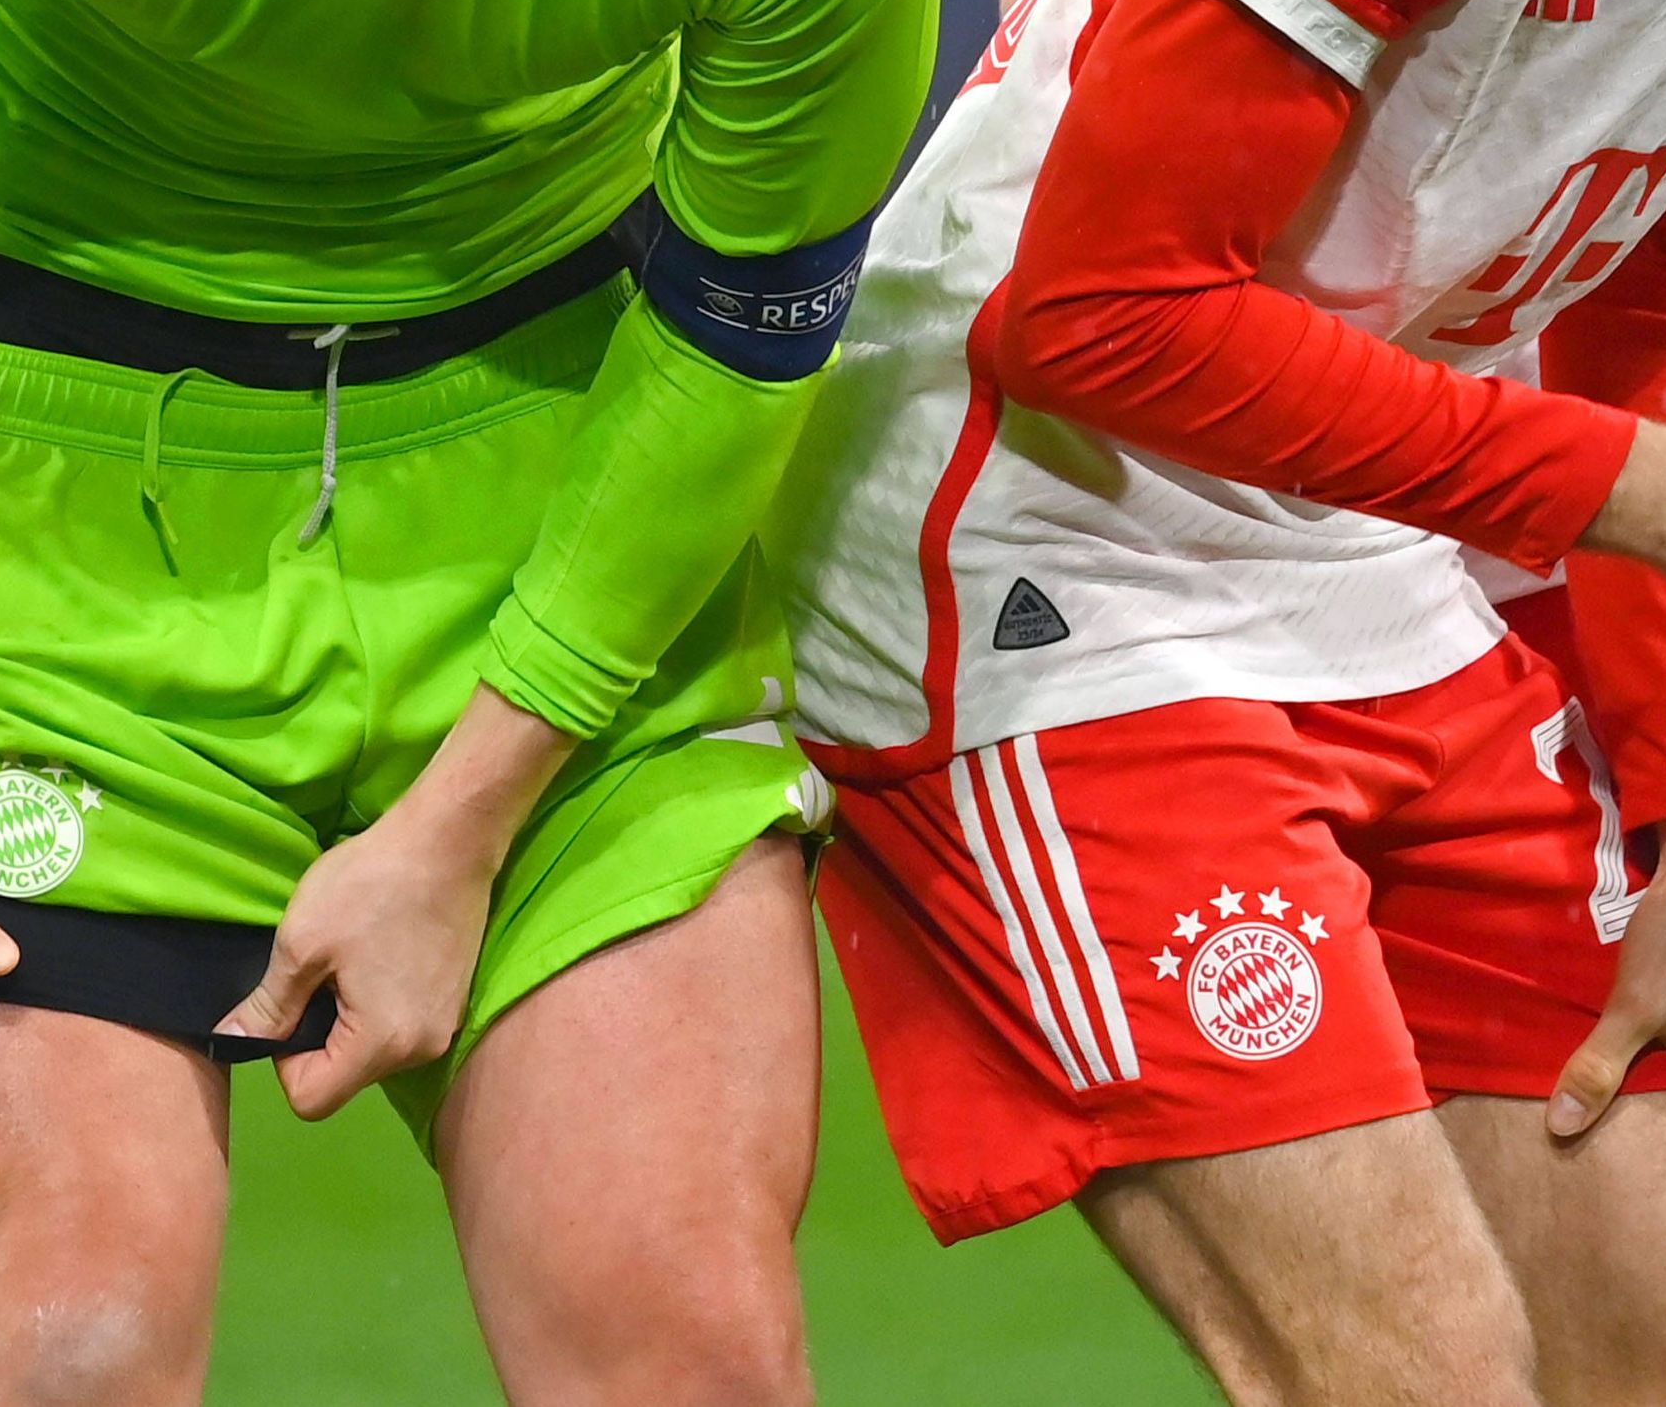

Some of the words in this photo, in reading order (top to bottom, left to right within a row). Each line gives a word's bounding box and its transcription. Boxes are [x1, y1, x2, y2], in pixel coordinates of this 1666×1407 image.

[1197, 963, 1218, 993] FC
[1213, 933, 1303, 971] BAYERN
[1208, 993, 1313, 1049] MÜNCHEN
